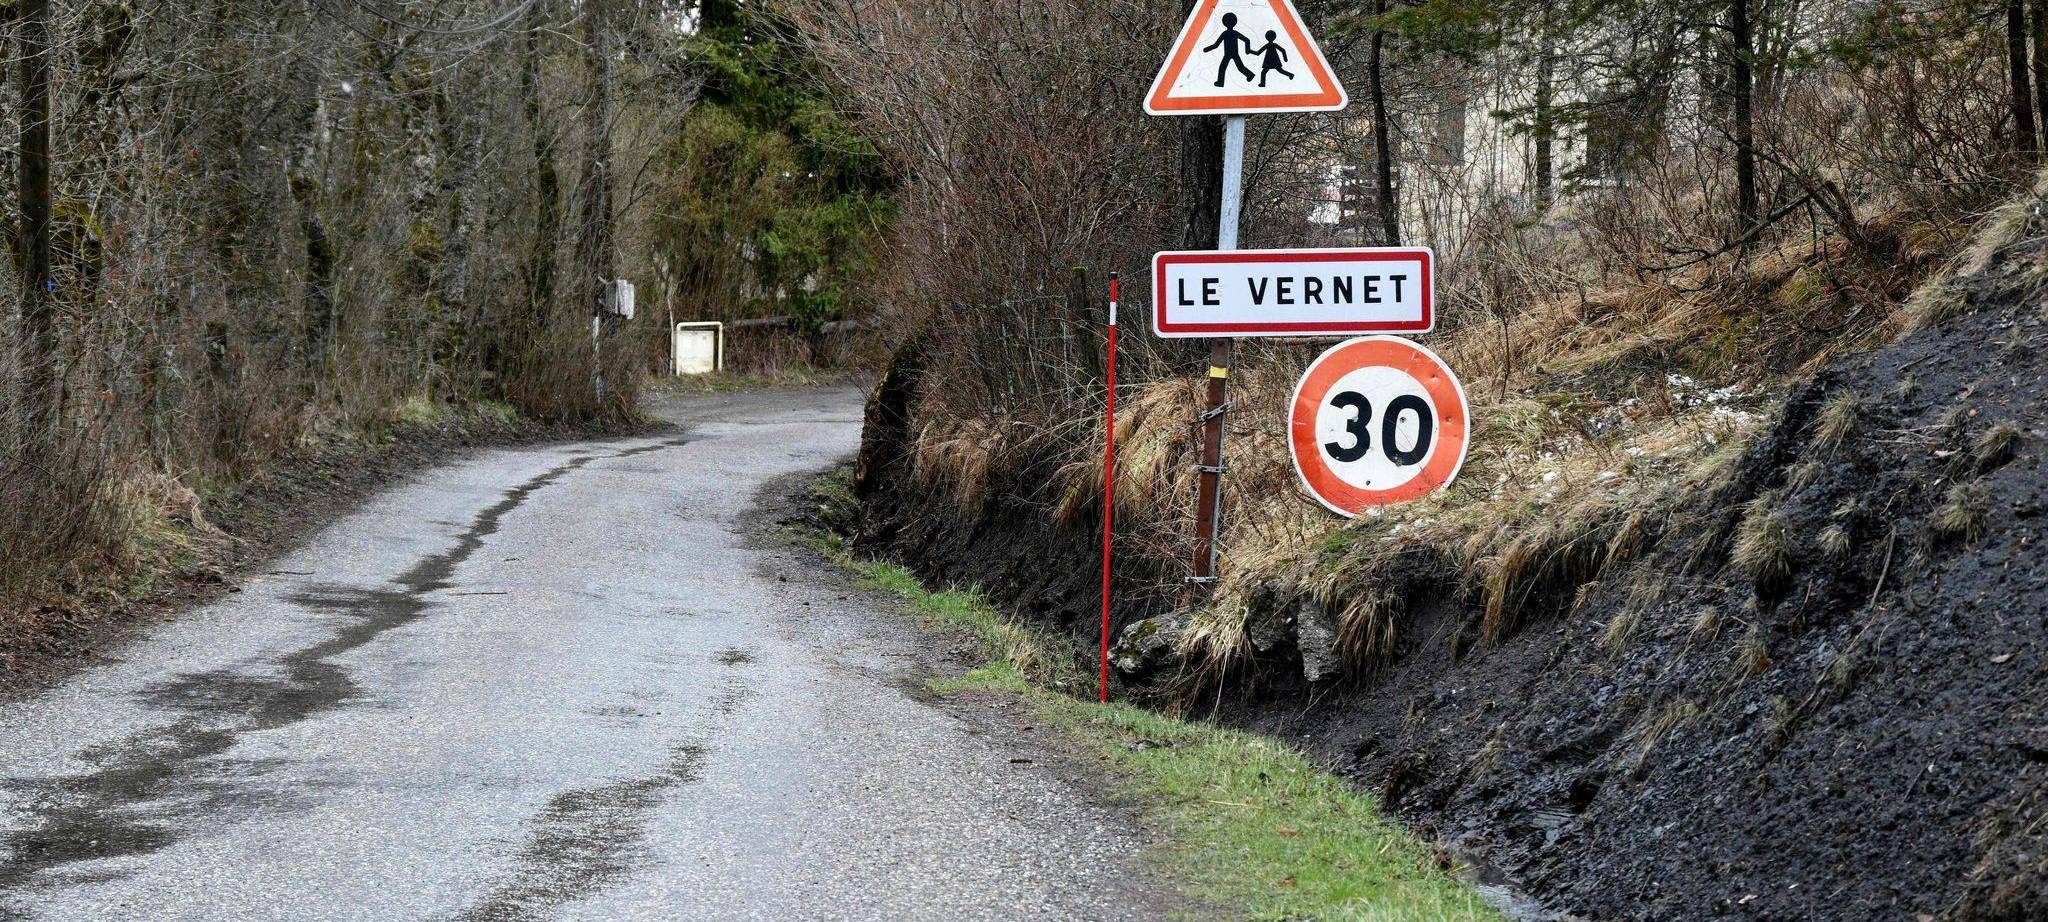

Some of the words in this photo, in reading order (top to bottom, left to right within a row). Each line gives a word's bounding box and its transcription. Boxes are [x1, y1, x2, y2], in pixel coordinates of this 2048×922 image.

[1178, 277, 1220, 306] LE
[1247, 274, 1407, 306] VERNET
[1324, 390, 1433, 466] 30
